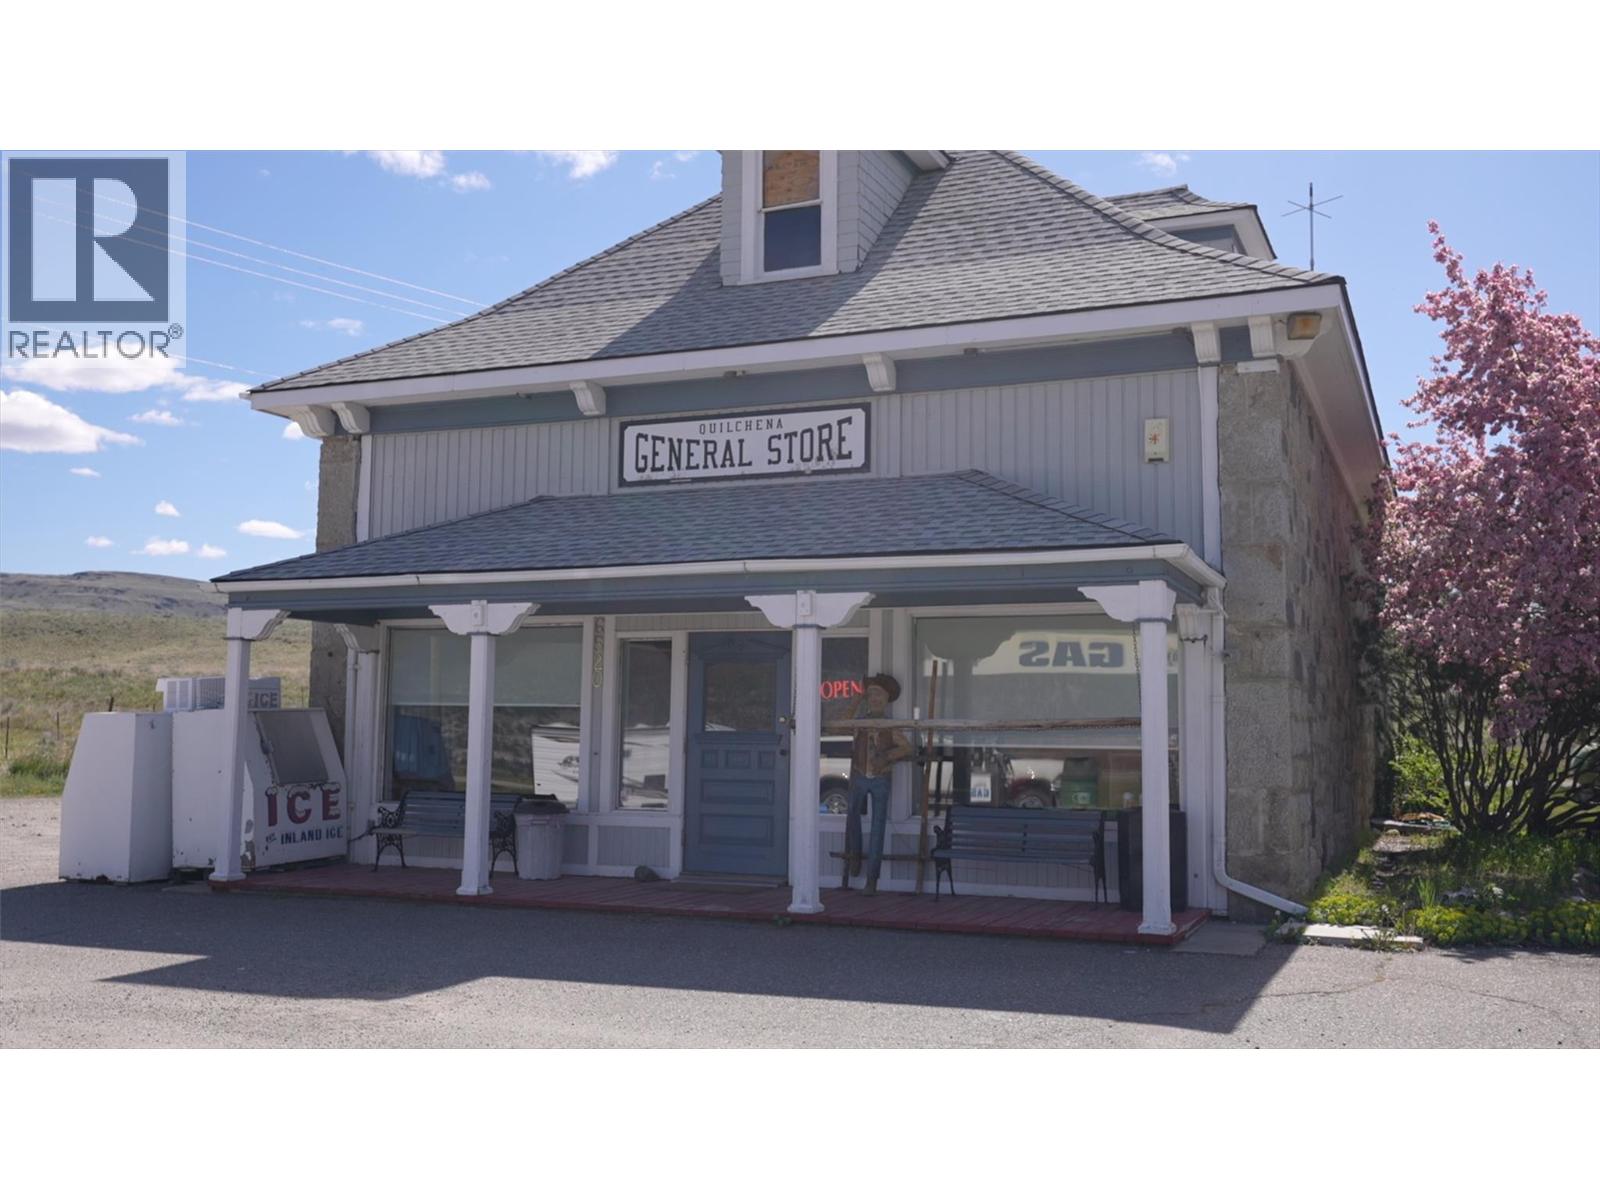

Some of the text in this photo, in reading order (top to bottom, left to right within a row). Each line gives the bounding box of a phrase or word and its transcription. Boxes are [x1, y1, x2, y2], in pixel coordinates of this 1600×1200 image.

[699, 418, 784, 435] QUILCHENA
[634, 416, 852, 473] GENERAL STORE
[820, 680, 864, 700] OPEN
[254, 692, 278, 709] ICE
[265, 782, 340, 827] ICE
[281, 829, 322, 845] INLAND
[326, 826, 343, 838] ICE
